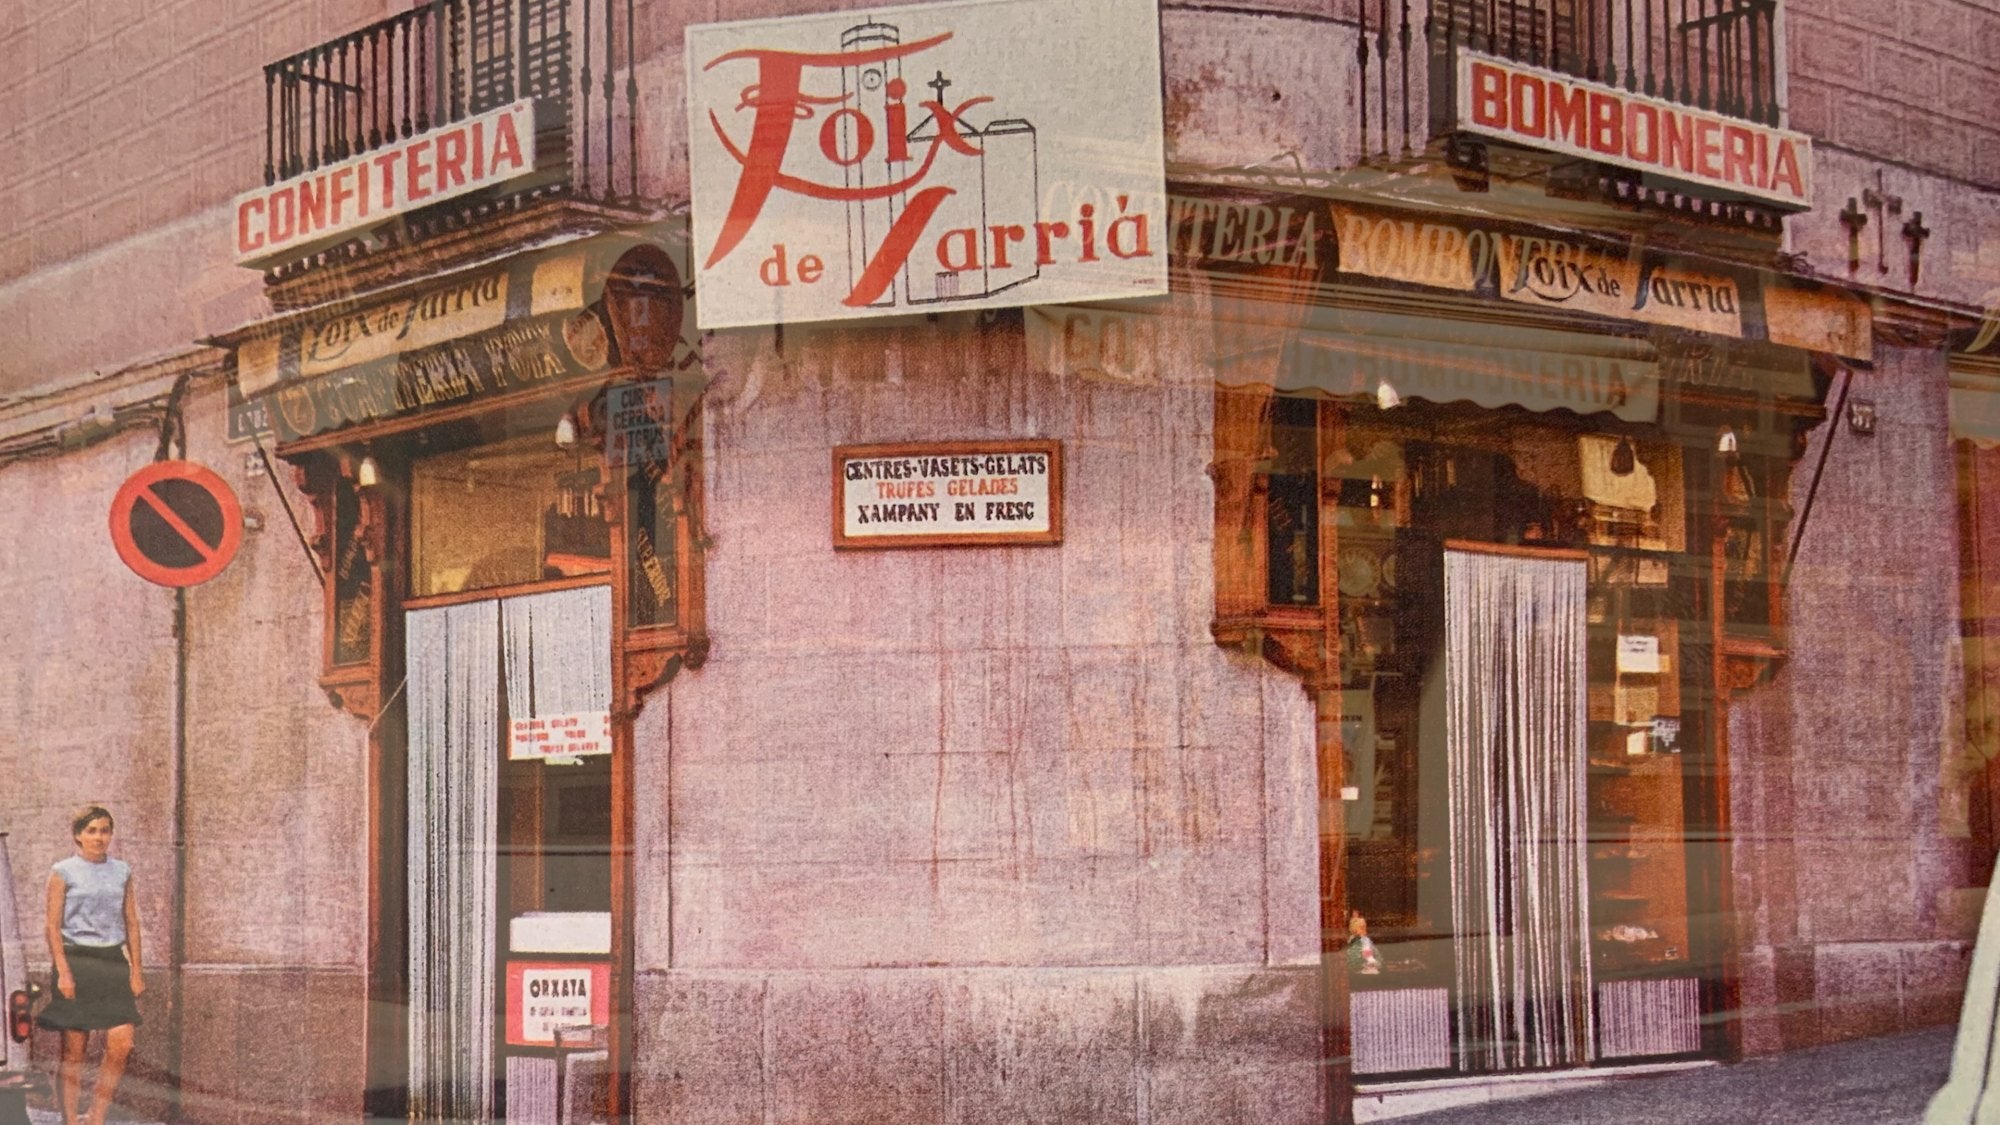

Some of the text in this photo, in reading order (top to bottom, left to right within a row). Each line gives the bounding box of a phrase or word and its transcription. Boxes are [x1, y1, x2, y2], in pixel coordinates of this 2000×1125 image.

[704, 31, 994, 270] Foix
[1470, 62, 1804, 198] BOMBONERIA
[237, 112, 525, 254] CONFITERIA
[759, 243, 825, 287] de
[876, 477, 1019, 499] TRUFES GELADES
[857, 501, 940, 524] XAMPANY
[954, 501, 976, 522] EN
[529, 978, 587, 998] ORXATA
